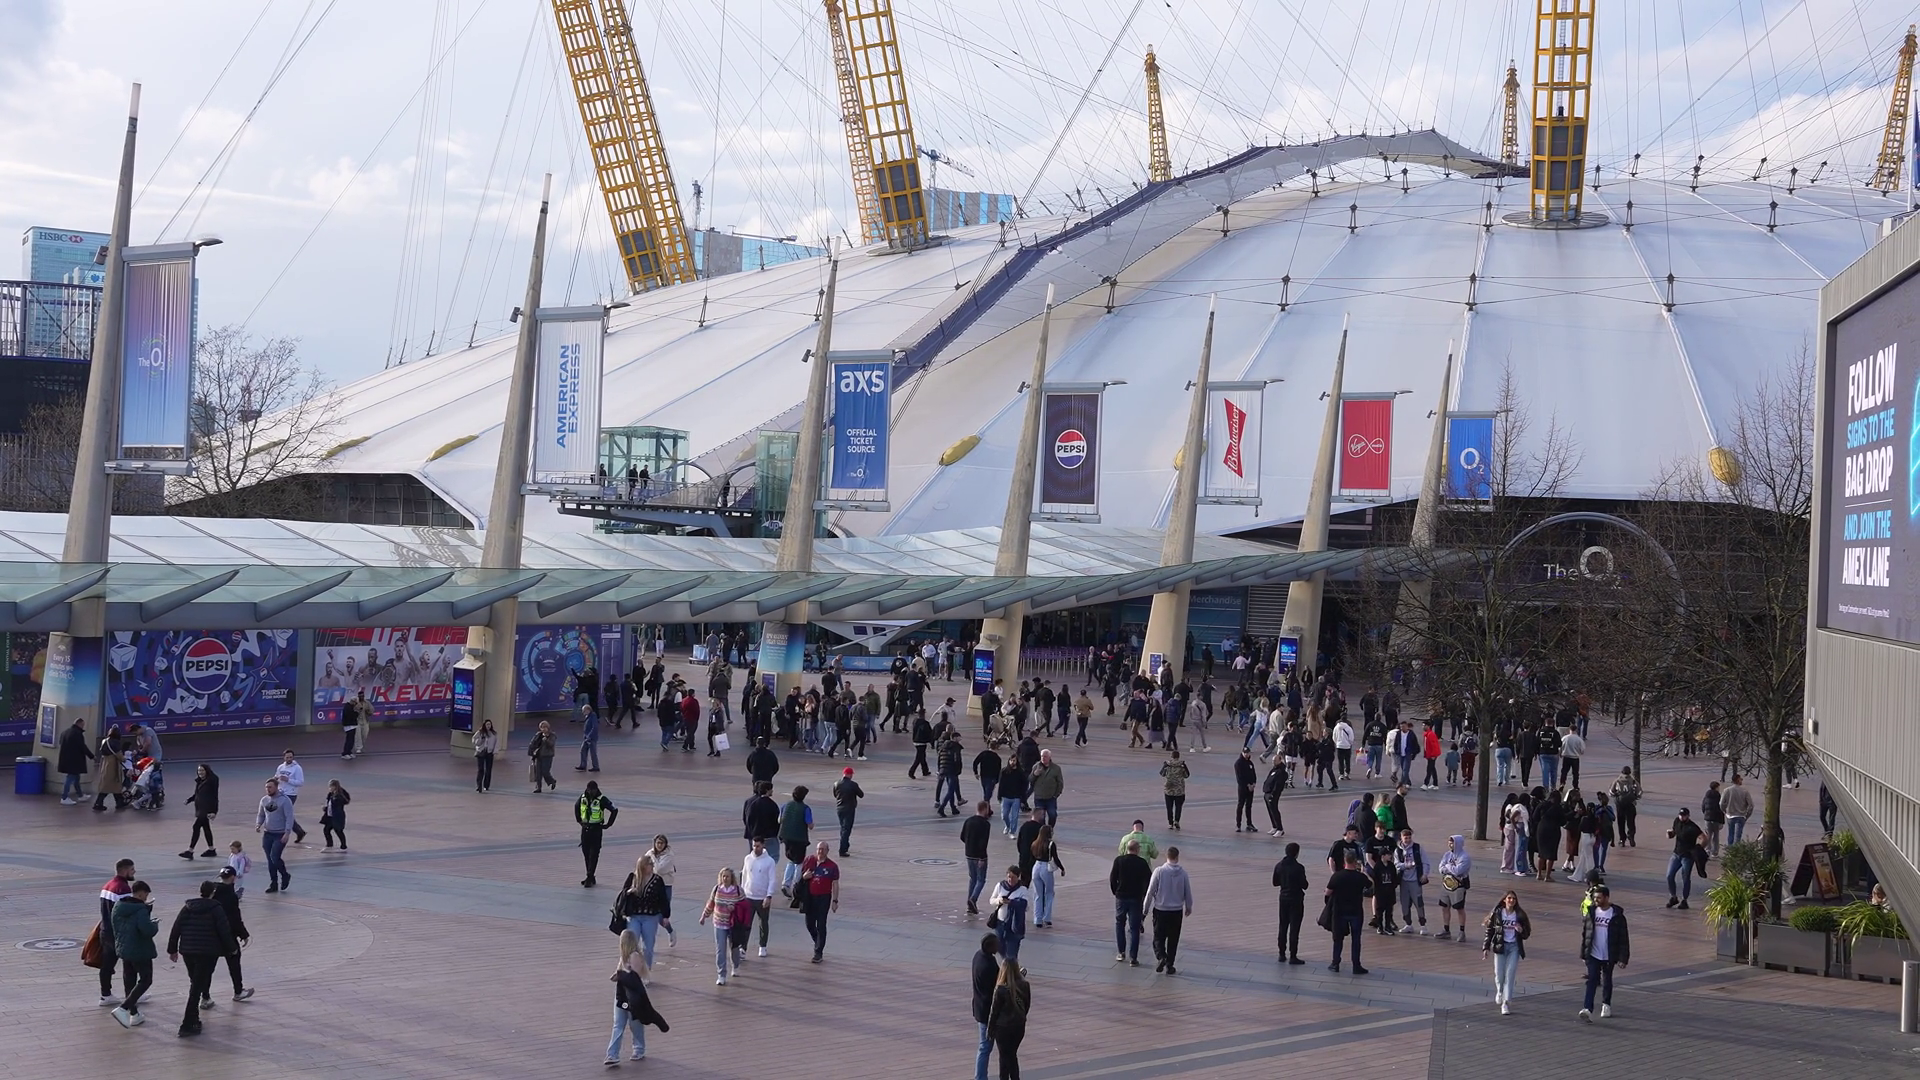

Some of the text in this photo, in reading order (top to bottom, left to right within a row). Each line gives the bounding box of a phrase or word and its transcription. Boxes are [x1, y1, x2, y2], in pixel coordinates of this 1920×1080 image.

[39, 231, 67, 242] HSBC
[138, 357, 150, 367] The
[568, 342, 580, 433] EXPRESS
[840, 370, 885, 396] axs
[1847, 342, 1897, 416] FOLLOW
[557, 344, 569, 448] AMERICAN
[846, 428, 877, 436] OFFICIAL
[850, 437, 873, 445] TICKET
[1227, 405, 1239, 470] Budweiser
[1846, 407, 1895, 449] SIGNS TO THE
[847, 445, 875, 453] SOURCE
[1057, 445, 1085, 453] PEPSI
[1845, 445, 1894, 498] BAG DROP
[1843, 509, 1892, 541] AND JOIN THE
[1543, 563, 1579, 580] The
[1842, 546, 1890, 587] AMEX LANE
[185, 659, 228, 672] PEPSI
